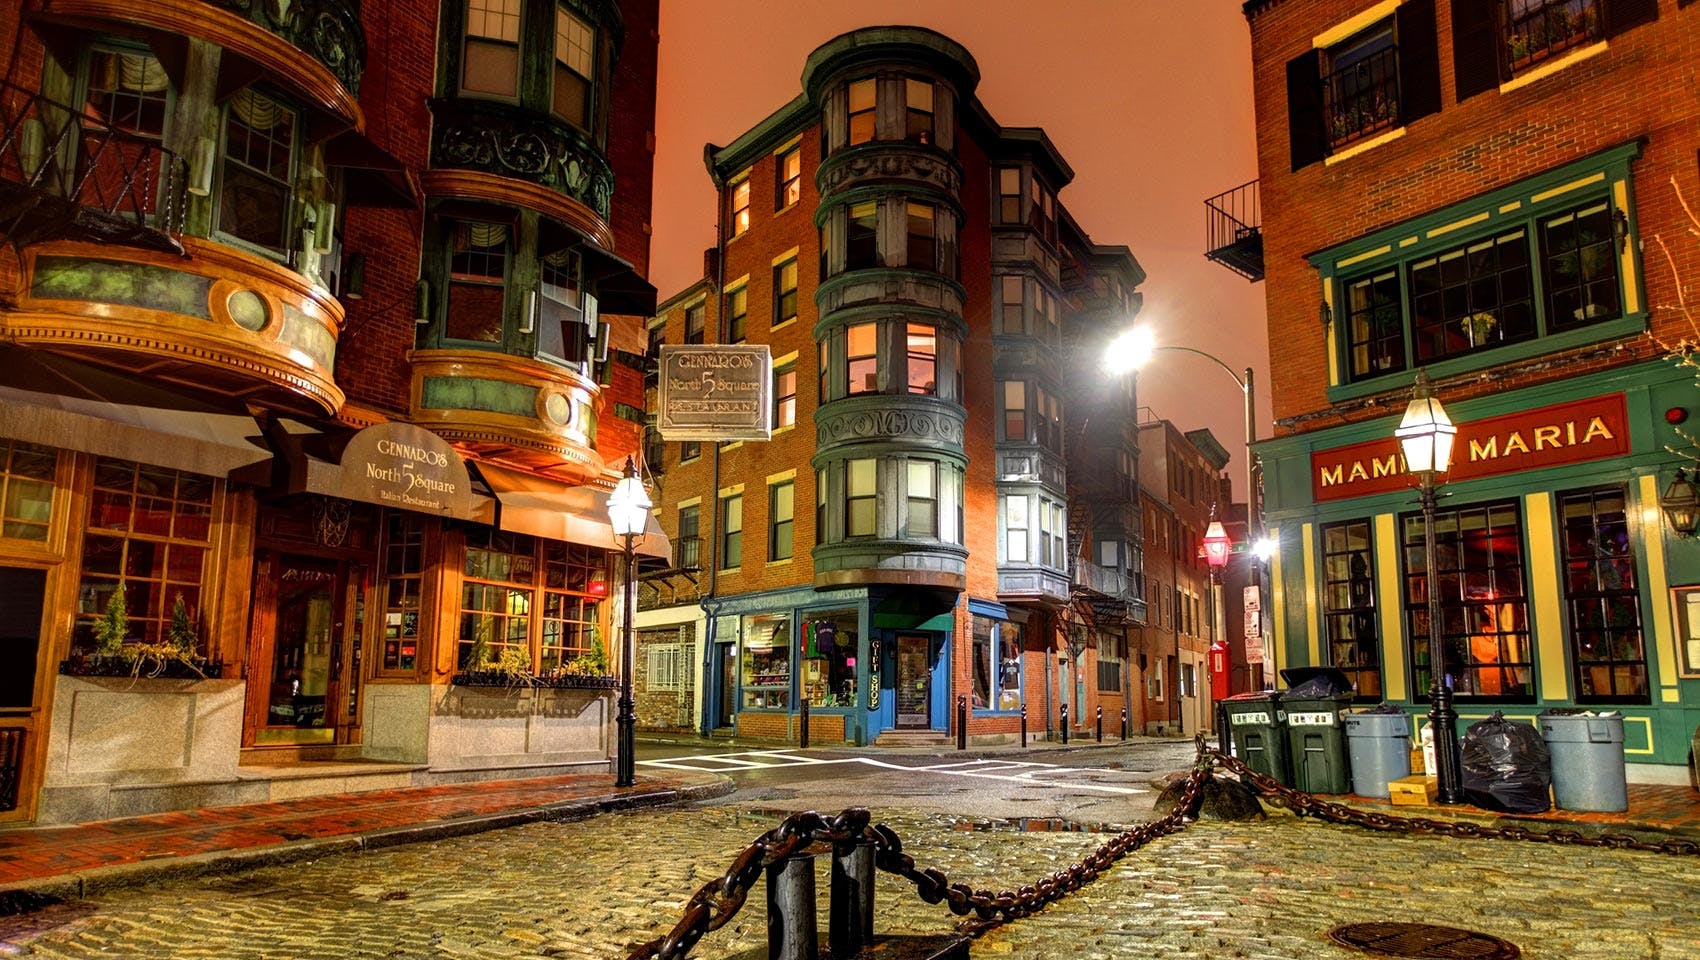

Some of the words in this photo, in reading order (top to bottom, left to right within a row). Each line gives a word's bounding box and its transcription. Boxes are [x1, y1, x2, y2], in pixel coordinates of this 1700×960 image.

[678, 354, 753, 369] GENNARO'S
[669, 378, 702, 391] North
[702, 370, 716, 399] 5
[717, 379, 760, 395] Square
[668, 401, 758, 412] RESTAURANT
[377, 439, 448, 468] GENNARO'S
[1469, 416, 1614, 462] MARIA
[366, 462, 401, 483] North
[402, 462, 415, 494] 5
[414, 473, 455, 494] Square
[402, 494, 440, 510] Restaurant
[872, 640, 880, 672] GIFT
[870, 675, 879, 707] SHOP
